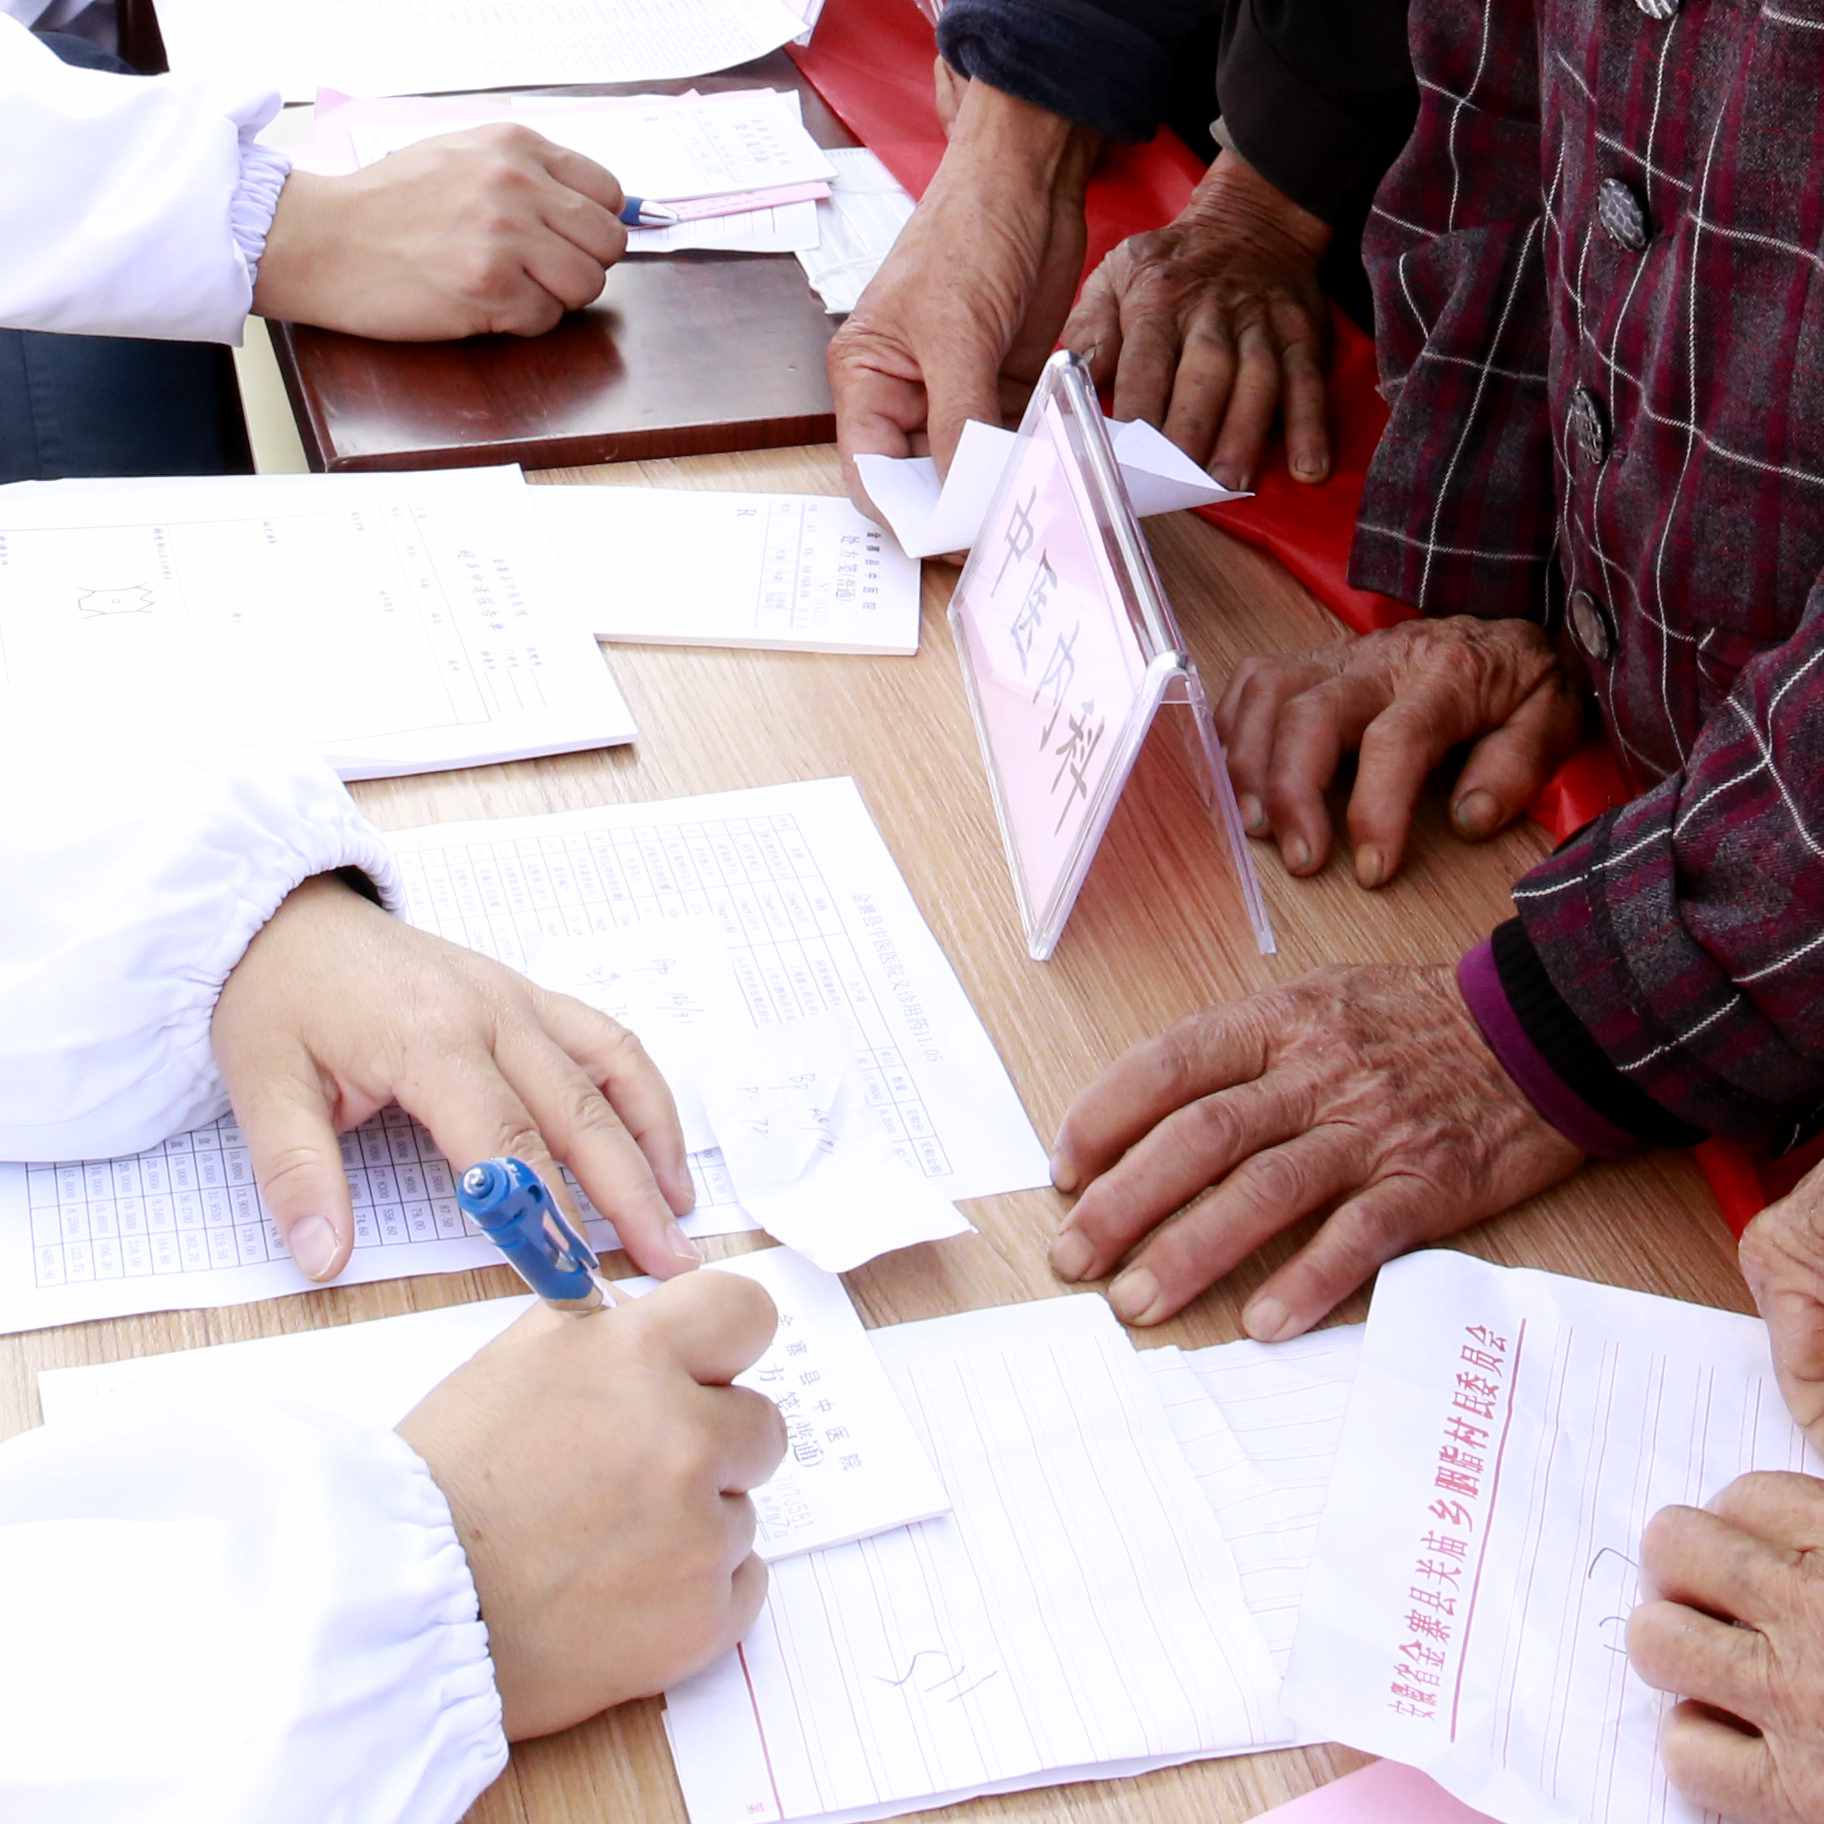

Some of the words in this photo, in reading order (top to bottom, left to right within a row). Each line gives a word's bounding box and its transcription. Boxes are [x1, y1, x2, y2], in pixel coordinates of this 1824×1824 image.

[990, 485, 1104, 837] 中医内科
[1387, 1324, 1508, 1721] 安徽省金寨县关庙乡胭脂村民委员会
